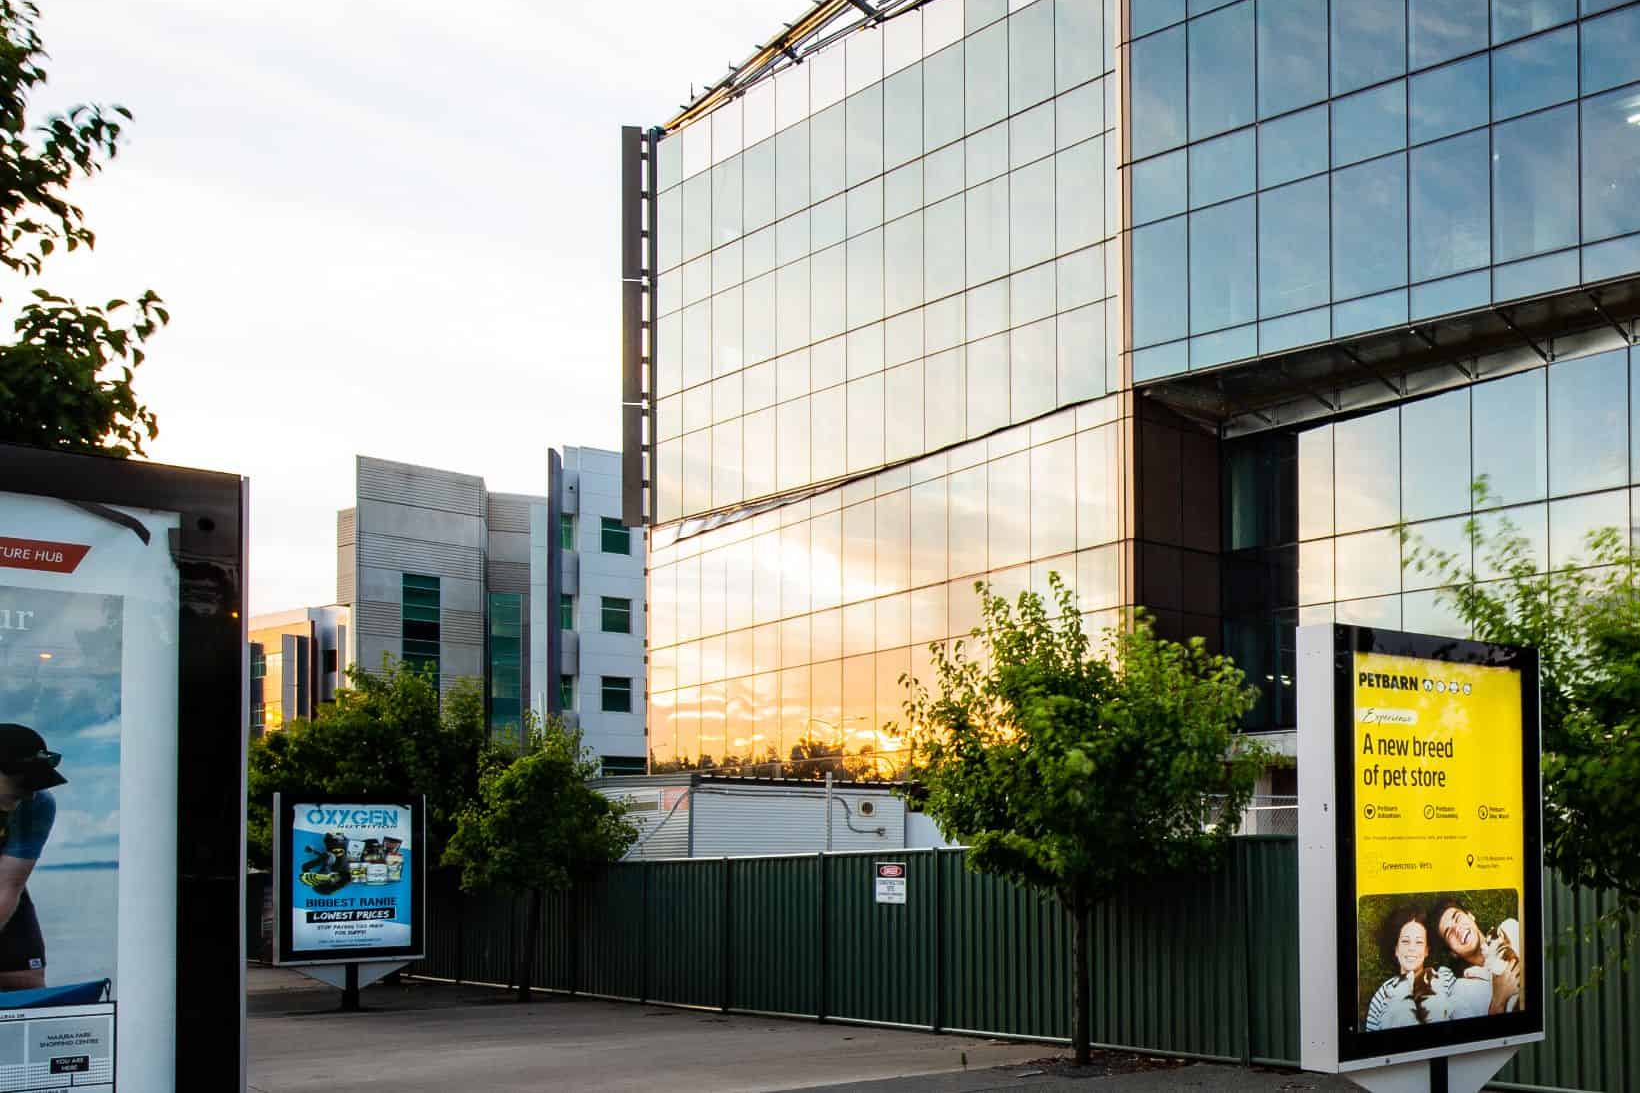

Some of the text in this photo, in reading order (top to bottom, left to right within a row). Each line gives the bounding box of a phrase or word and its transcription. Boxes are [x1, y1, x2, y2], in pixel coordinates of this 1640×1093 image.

[34, 550, 64, 563] HUB
[1359, 672, 1418, 691] PETBARN
[1363, 733, 1454, 758] A new breed
[1363, 764, 1446, 790] of pet store
[306, 810, 398, 825] OXYGEN
[306, 898, 354, 907] BIGGEST
[313, 909, 391, 920] LOWEST PRICES
